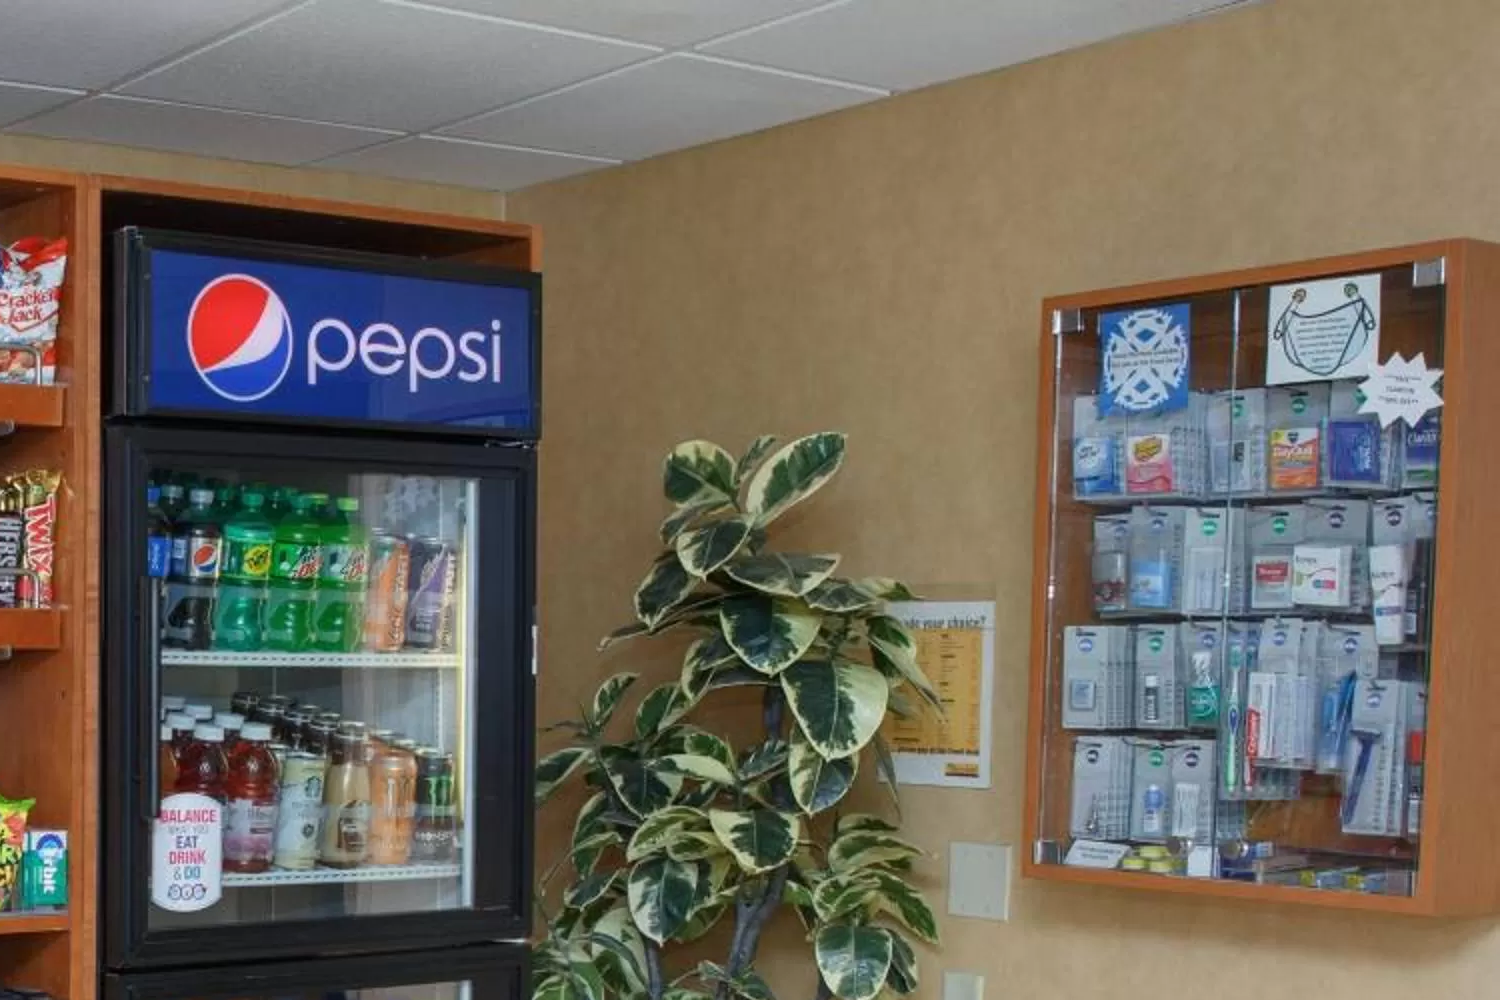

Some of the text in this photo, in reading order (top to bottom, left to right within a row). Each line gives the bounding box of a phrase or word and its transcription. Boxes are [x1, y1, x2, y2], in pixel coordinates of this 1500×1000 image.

[308, 317, 502, 393] pepsi
[158, 809, 217, 823] BALANCE
[175, 835, 198, 849] EAT
[169, 851, 206, 865] DRINK
